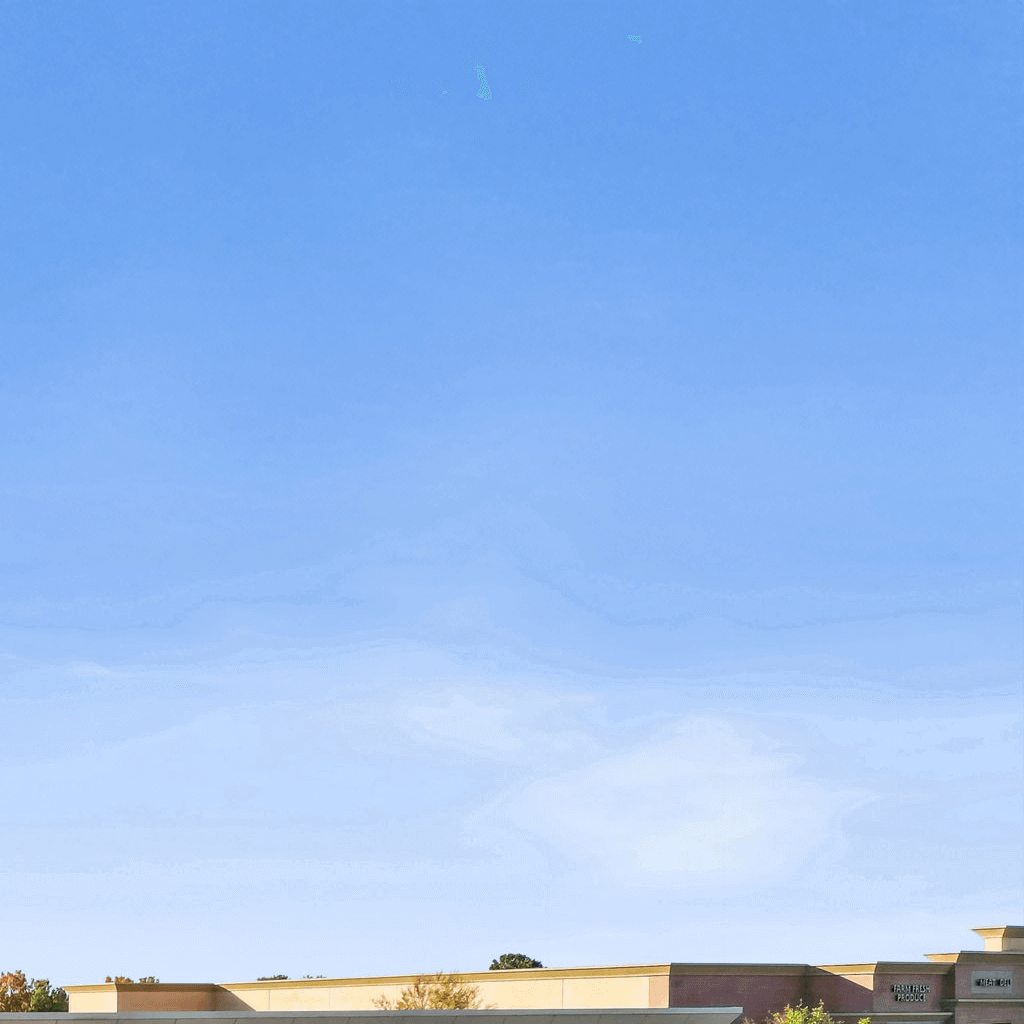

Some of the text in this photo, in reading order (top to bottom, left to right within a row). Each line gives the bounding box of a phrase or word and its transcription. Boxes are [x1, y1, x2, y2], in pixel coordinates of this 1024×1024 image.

[893, 984, 931, 993] FARM FRESH
[897, 993, 928, 1002] PRODUCE
